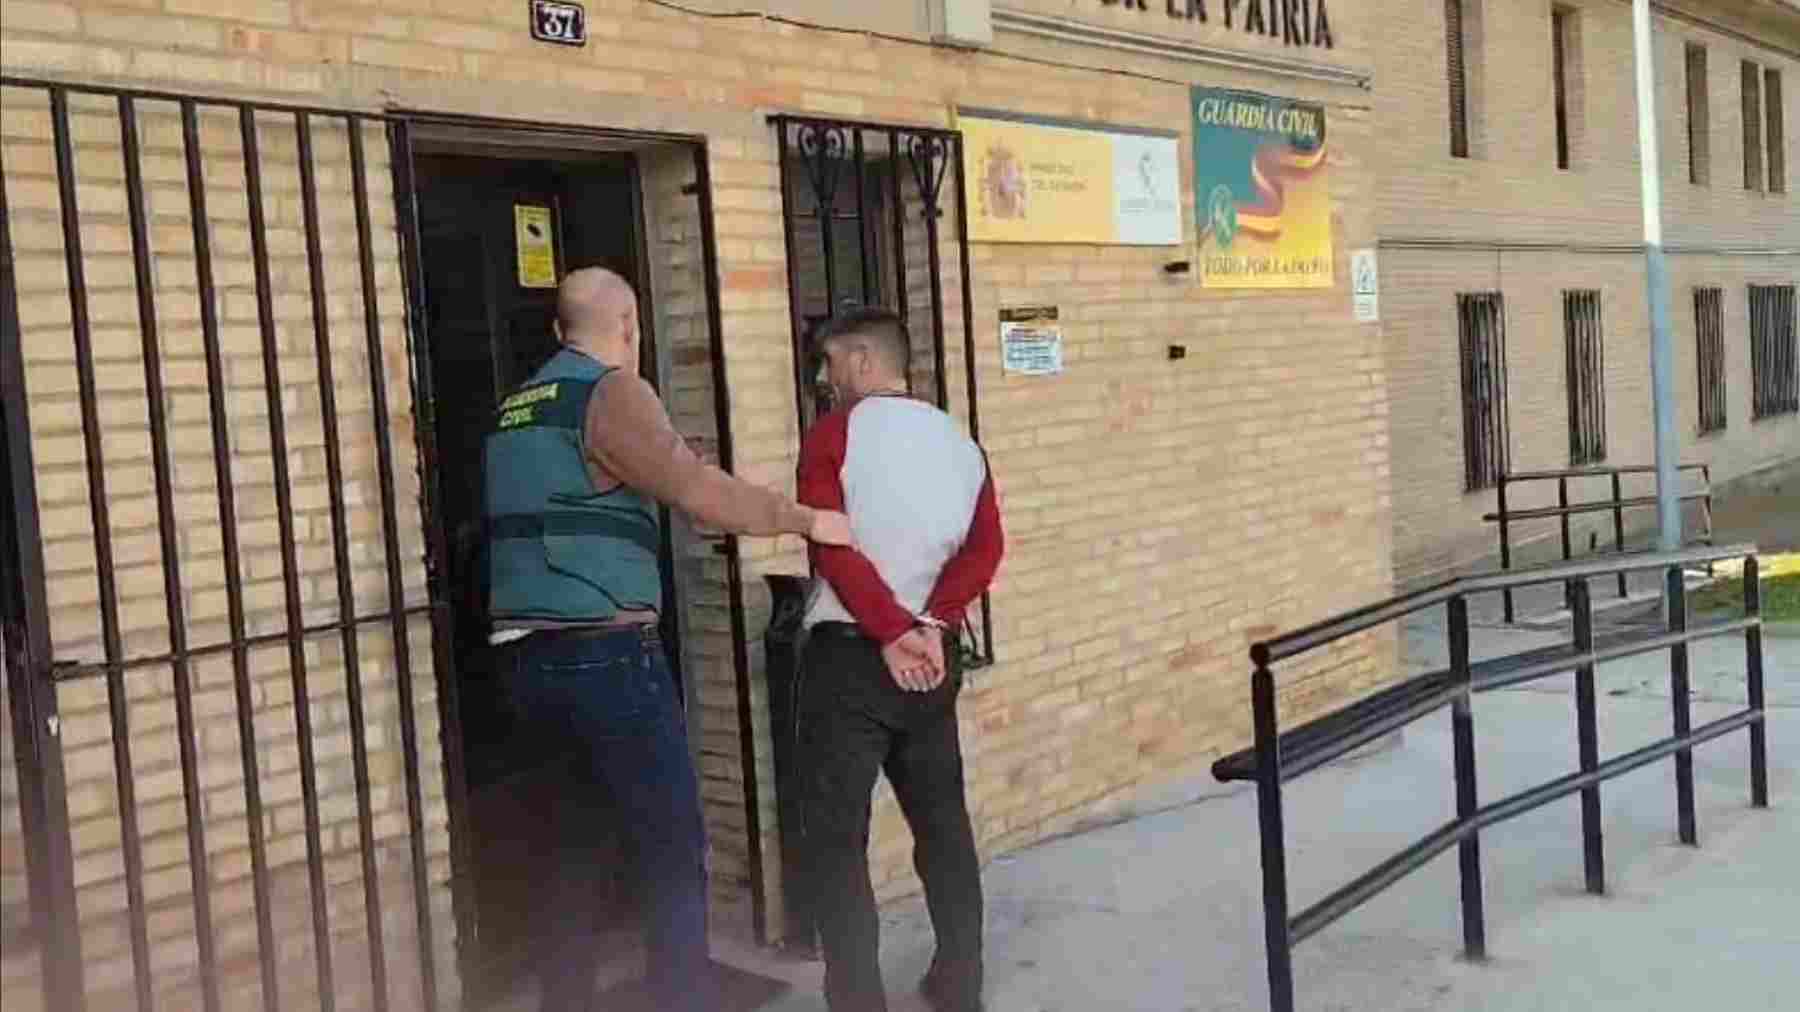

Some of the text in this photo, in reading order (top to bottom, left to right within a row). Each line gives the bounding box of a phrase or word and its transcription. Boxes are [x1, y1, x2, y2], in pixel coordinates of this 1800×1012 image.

[544, 7, 576, 37] 37
[1198, 97, 1318, 138] GUARDIA CIVIL
